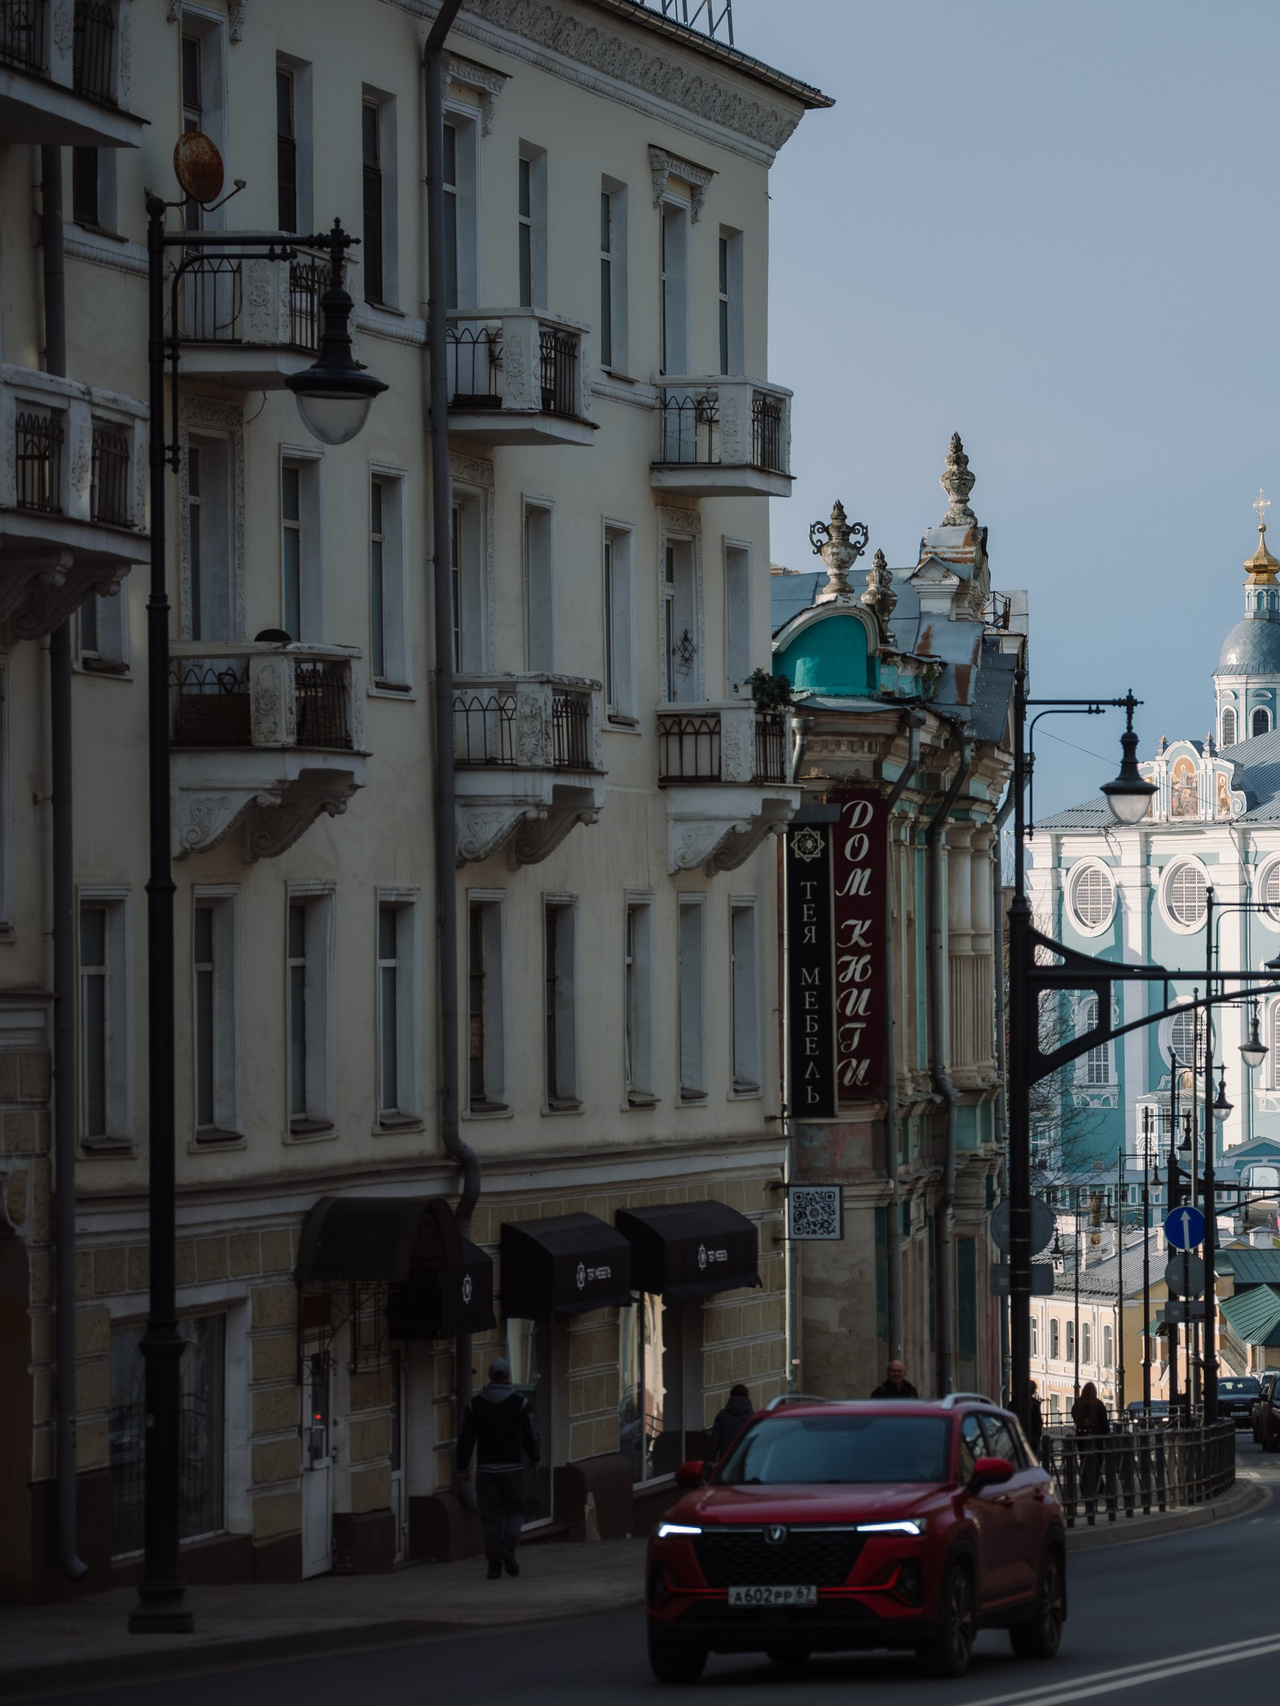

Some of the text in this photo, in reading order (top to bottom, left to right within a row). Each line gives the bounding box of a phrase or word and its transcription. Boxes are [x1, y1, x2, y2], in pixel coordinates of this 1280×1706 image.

[800, 881, 821, 1104] ТЕЯ МЕБЕЛЬ
[835, 799, 874, 1087] ДОМ КНИГИ
[734, 1587, 812, 1604] А602РР 67
